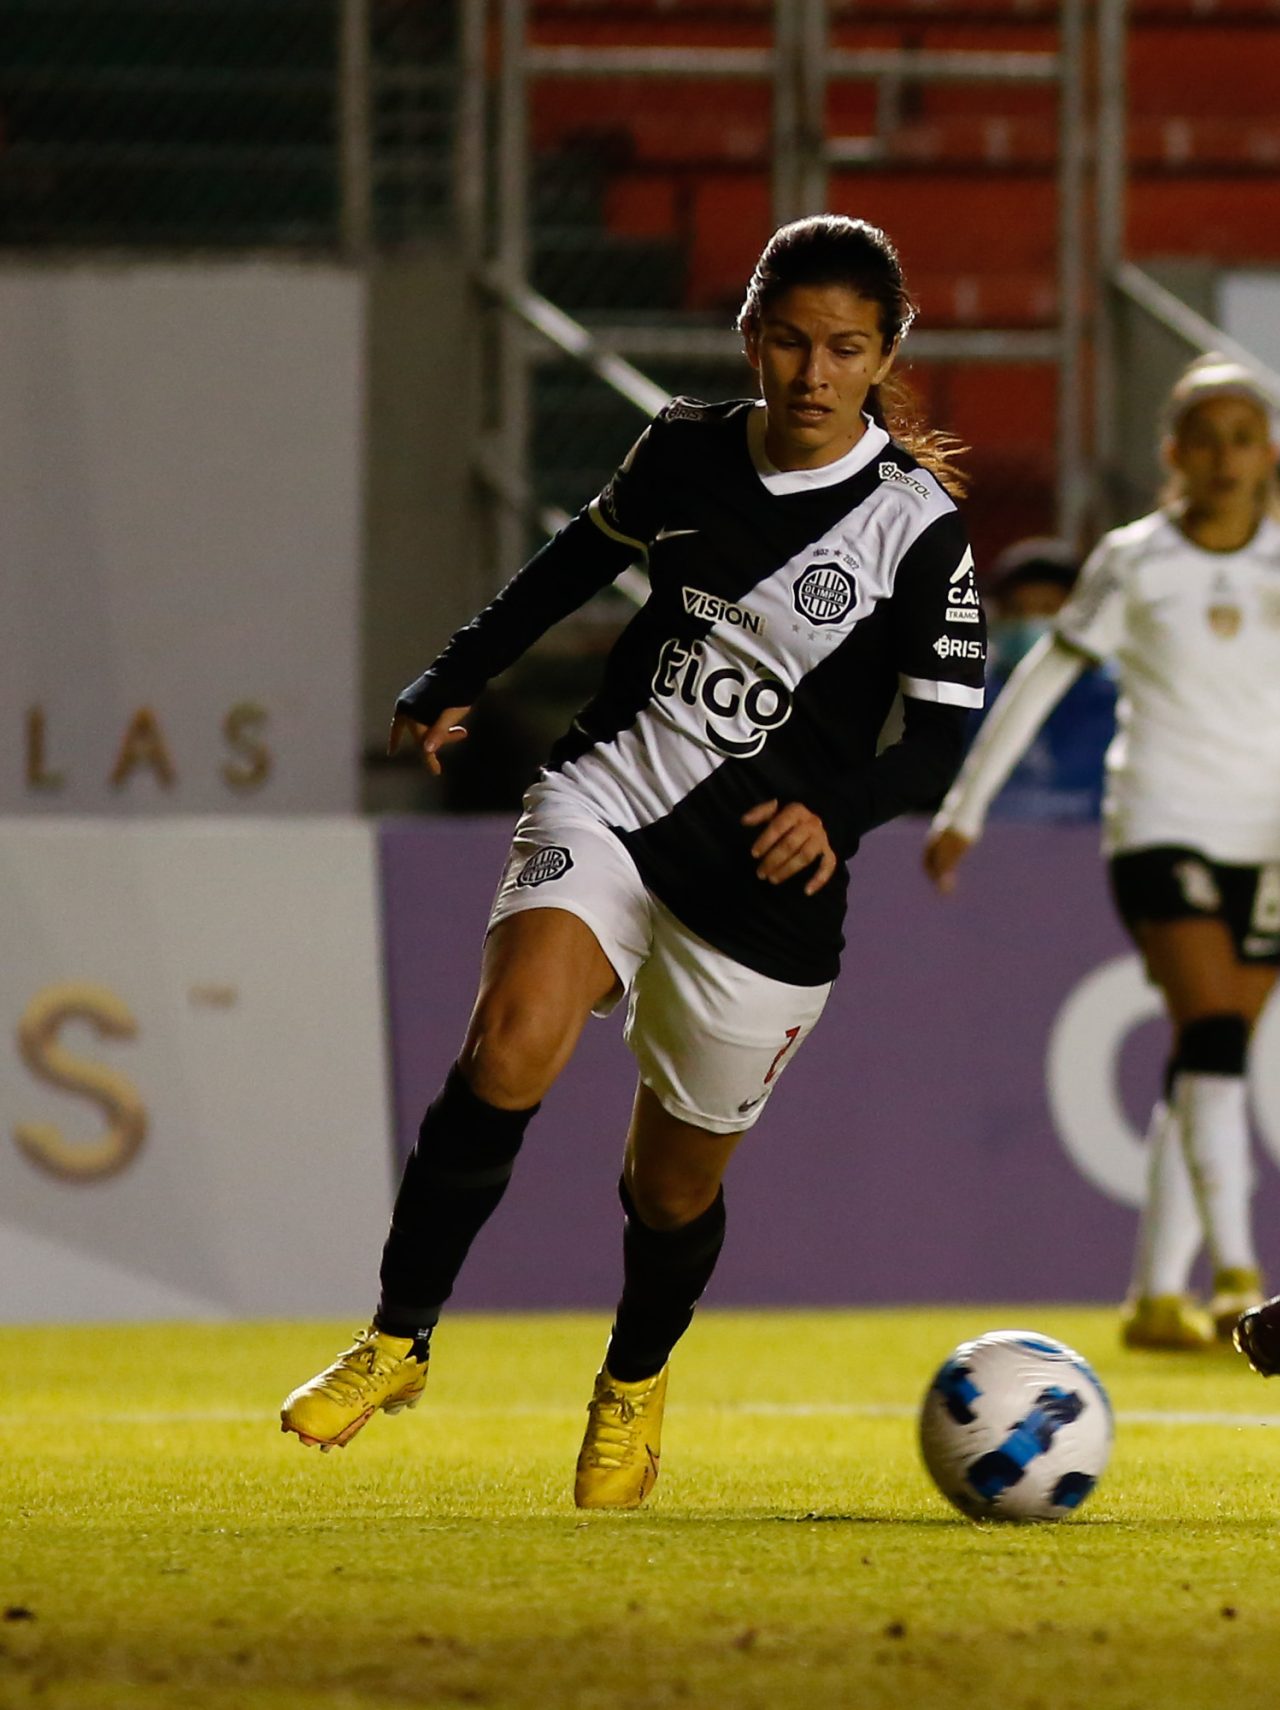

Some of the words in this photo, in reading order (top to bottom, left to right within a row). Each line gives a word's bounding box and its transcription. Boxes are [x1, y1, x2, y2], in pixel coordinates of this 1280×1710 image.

[879, 461, 931, 500] BRISTOL
[804, 584, 845, 603] OLIMPIA
[947, 587, 980, 605] CA
[13, 978, 149, 1188] S
